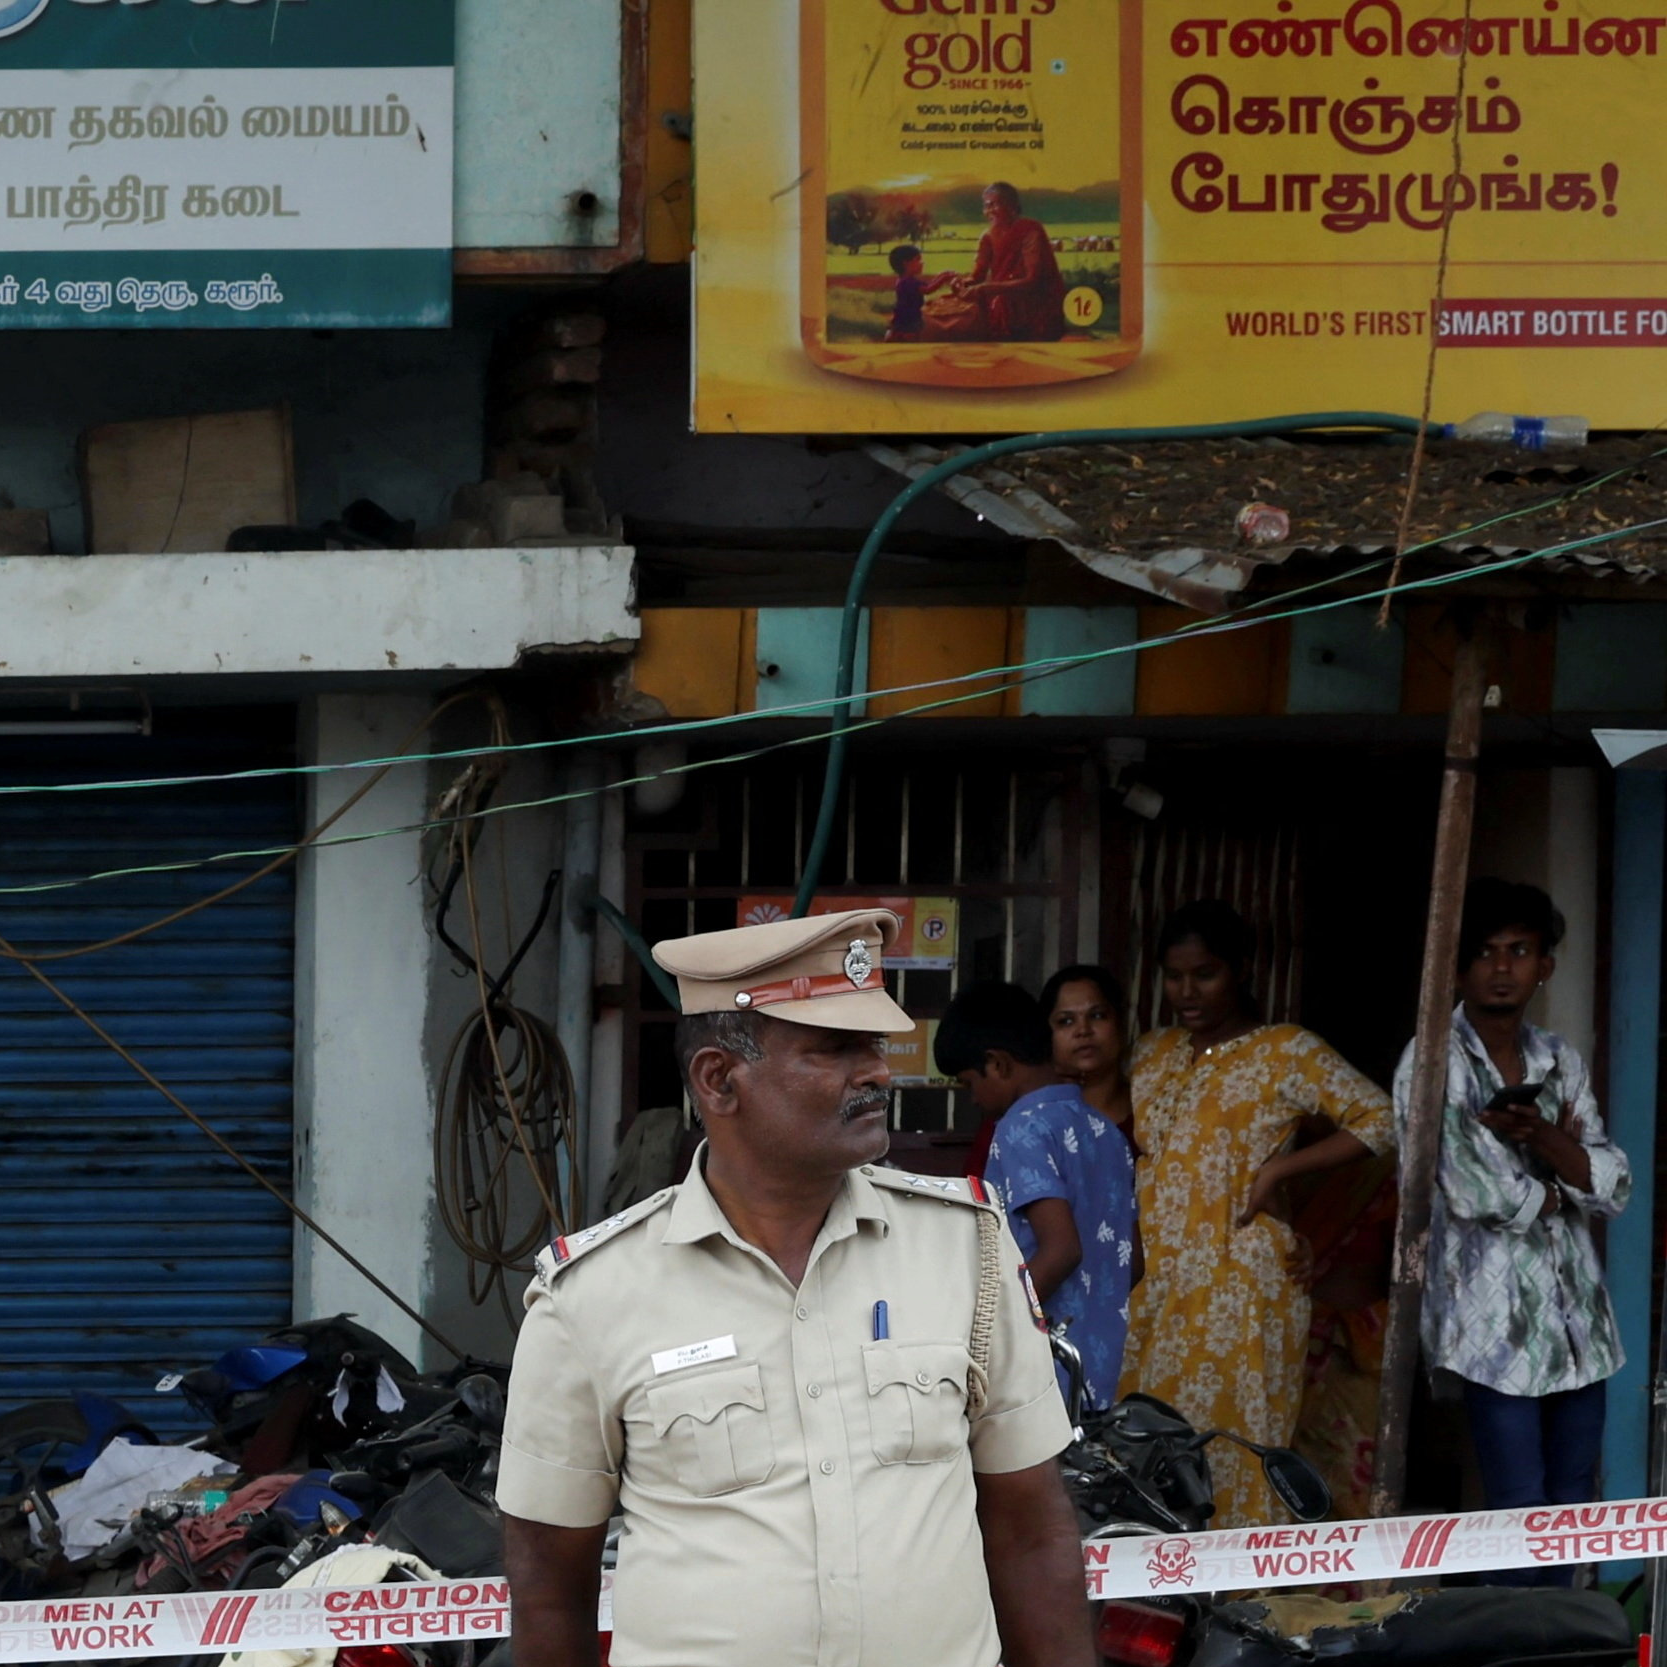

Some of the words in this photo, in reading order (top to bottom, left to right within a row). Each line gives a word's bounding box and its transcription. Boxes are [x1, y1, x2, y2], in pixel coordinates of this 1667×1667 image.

[903, 18, 1032, 90] gold
[68, 94, 229, 151] தகவல்
[241, 93, 410, 139] மையம்
[1171, 74, 1522, 155] கொஞ்சம்
[7, 174, 169, 231] பாத்திர
[182, 183, 301, 217] கடை
[1171, 152, 1620, 233] போதுமுங்க!
[24, 277, 49, 304] 4
[55, 279, 113, 312] வது
[1226, 312, 1345, 336] WORLD'S
[1354, 311, 1427, 336] FIRST
[1437, 310, 1524, 336] SMART
[1533, 310, 1627, 336] BOTTLE
[1524, 1500, 1667, 1532] CAUTIO
[1246, 1528, 1315, 1550] MEN
[1325, 1525, 1367, 1545] AT
[1253, 1548, 1355, 1578] WORK
[44, 1603, 114, 1623] MEN
[123, 1600, 164, 1619] AT
[324, 1583, 509, 1613] CAUTION
[51, 1624, 154, 1651] WORK
[326, 1607, 509, 1642] सावधान
